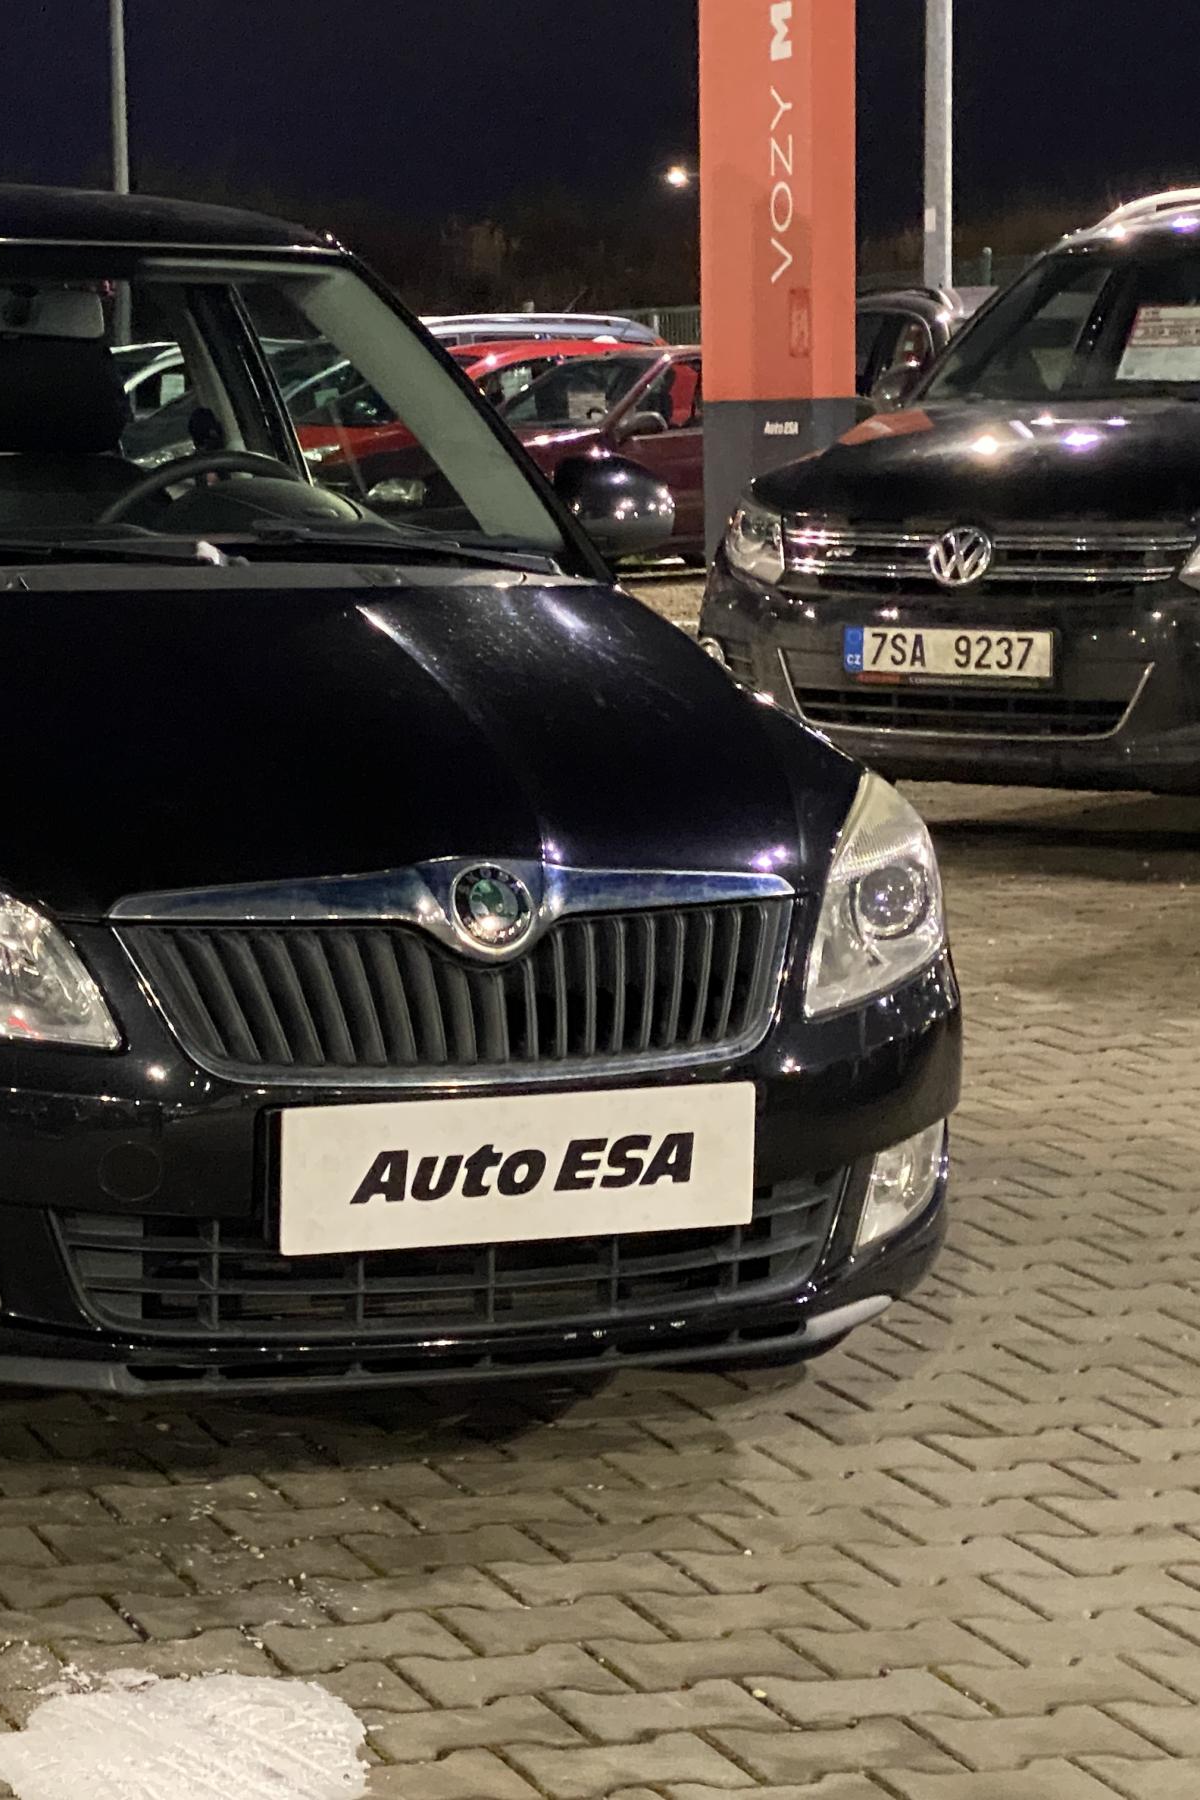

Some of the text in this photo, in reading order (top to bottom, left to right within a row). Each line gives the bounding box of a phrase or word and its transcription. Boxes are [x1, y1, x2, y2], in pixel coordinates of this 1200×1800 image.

[769, 1, 794, 283] VOZY M
[846, 653, 862, 665] CZ
[870, 632, 1034, 671] 7SA 9237
[349, 1131, 695, 1205] Auto ESA
